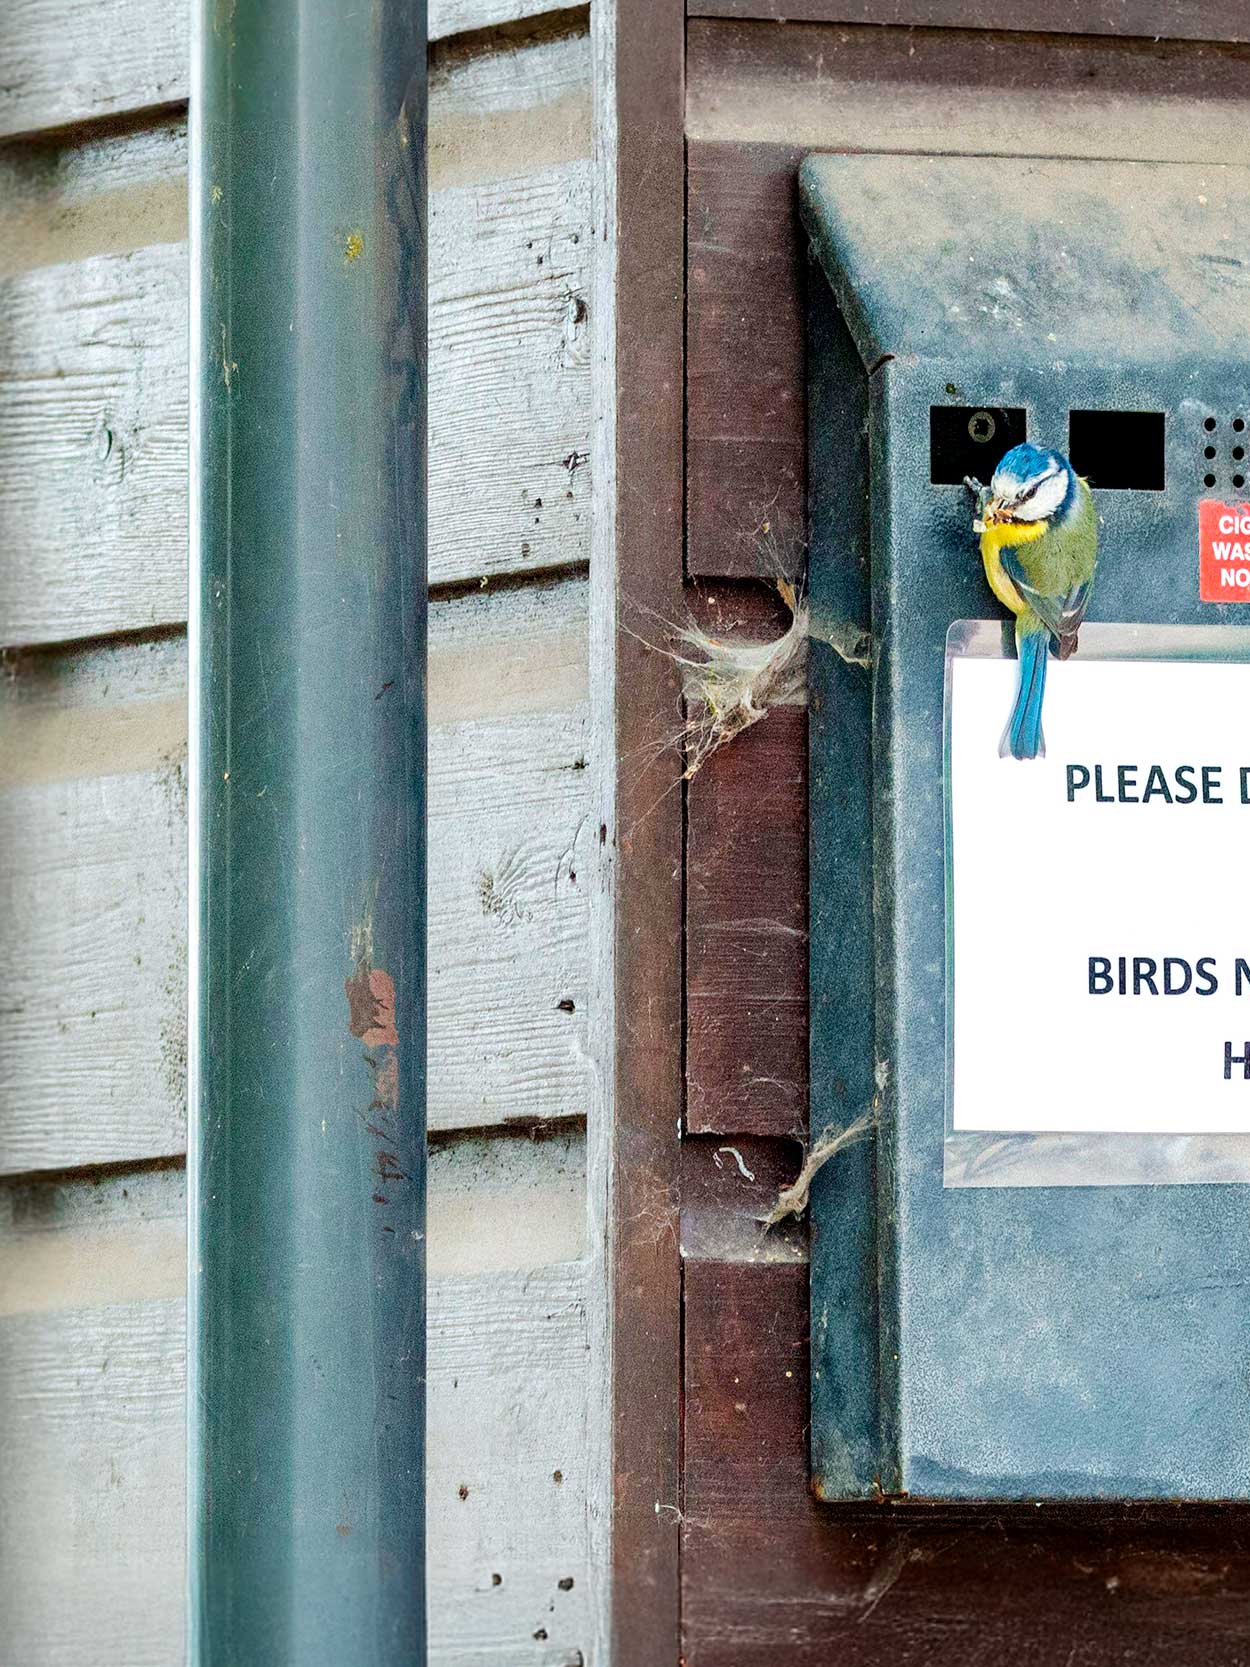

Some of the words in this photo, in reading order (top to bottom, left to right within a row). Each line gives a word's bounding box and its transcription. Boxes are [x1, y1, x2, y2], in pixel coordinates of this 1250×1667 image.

[1221, 569, 1250, 588] NO
[1066, 764, 1224, 804] PLEASE
[1088, 956, 1219, 996] BIRDS
